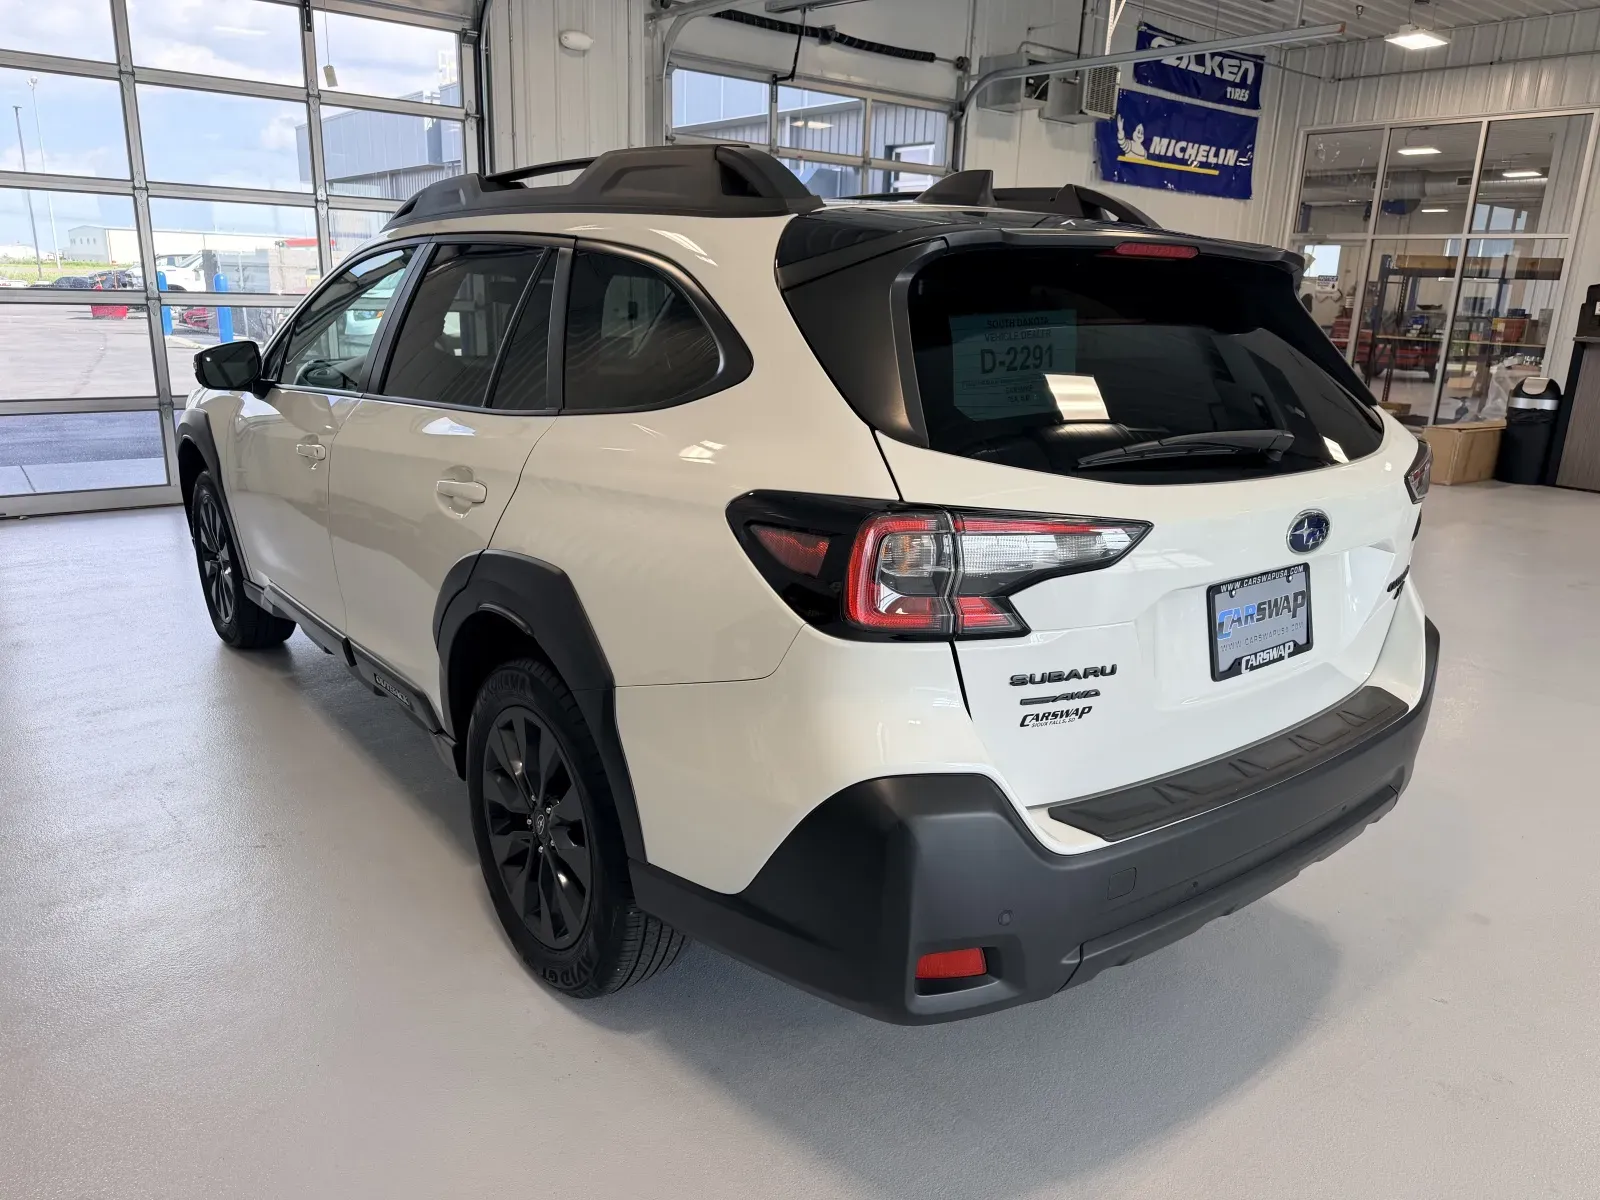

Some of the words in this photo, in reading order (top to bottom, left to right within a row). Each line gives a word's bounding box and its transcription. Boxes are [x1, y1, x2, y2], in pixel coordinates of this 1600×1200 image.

[1226, 86, 1250, 102] TIRES
[1150, 136, 1239, 167] MICHELIN
[987, 318, 1016, 329] SOUTH
[1016, 316, 1050, 328] DAKOTA
[984, 333, 1019, 343] VEHICLE
[980, 343, 1055, 375] D-2291
[1220, 565, 1304, 593] WWW.CARSWAPUSA.COM
[1217, 590, 1307, 641] CARSWAP
[1241, 641, 1294, 674] CARSWAP
[1008, 663, 1118, 687] SUBARU
[1051, 689, 1101, 703] AWD
[1019, 705, 1093, 728] CARSWAP
